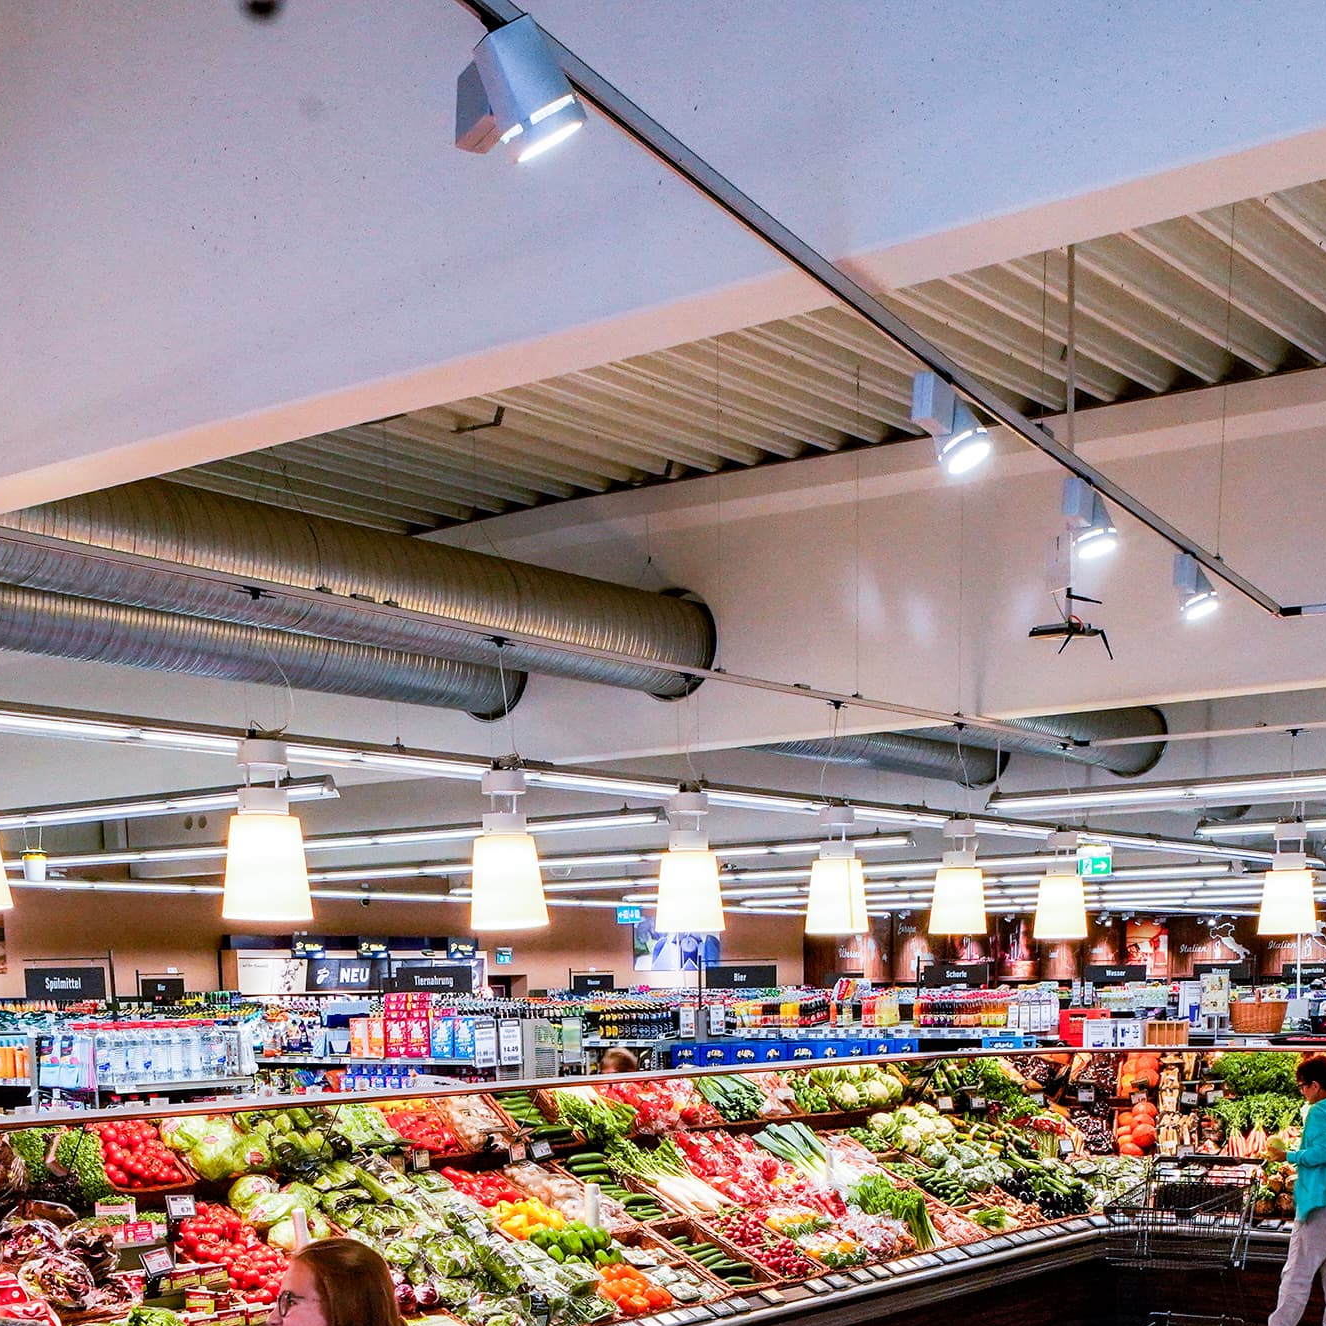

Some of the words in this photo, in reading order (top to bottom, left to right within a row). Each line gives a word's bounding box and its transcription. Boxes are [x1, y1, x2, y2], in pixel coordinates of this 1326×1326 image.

[339, 967, 370, 983] NEU
[733, 972, 747, 982] Bier
[945, 970, 968, 979] Schorle
[1105, 969, 1126, 978] Wasser
[45, 976, 81, 992] Spülmittel
[414, 975, 454, 988] Tiernahrung
